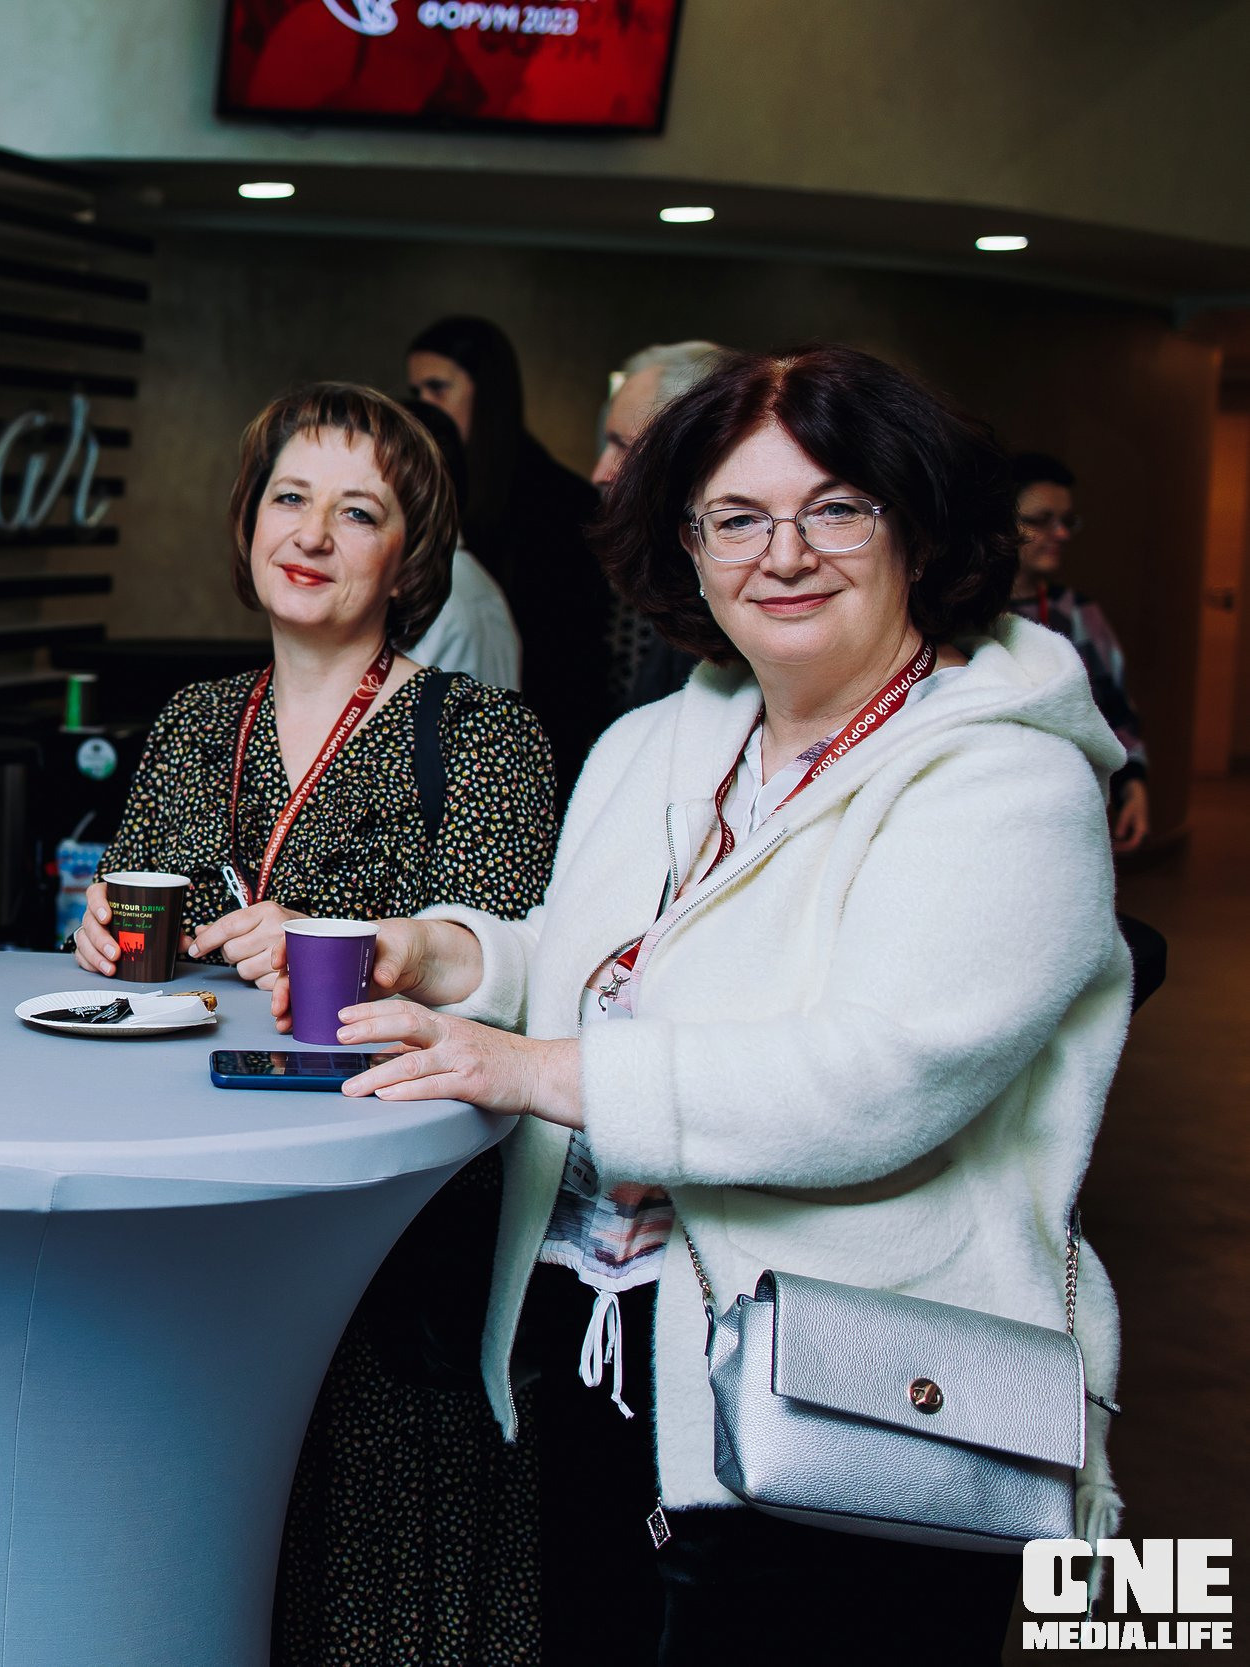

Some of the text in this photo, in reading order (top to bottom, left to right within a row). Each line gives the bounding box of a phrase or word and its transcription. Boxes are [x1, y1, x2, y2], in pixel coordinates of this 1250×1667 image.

[874, 644, 933, 716] КУЛЬТУРНЫЙ
[833, 713, 877, 757] ФОРУМ
[257, 706, 362, 900] БАЛТИЙСКИЙ КУЛЬТУРНЫЙ ФОРУМ 2023
